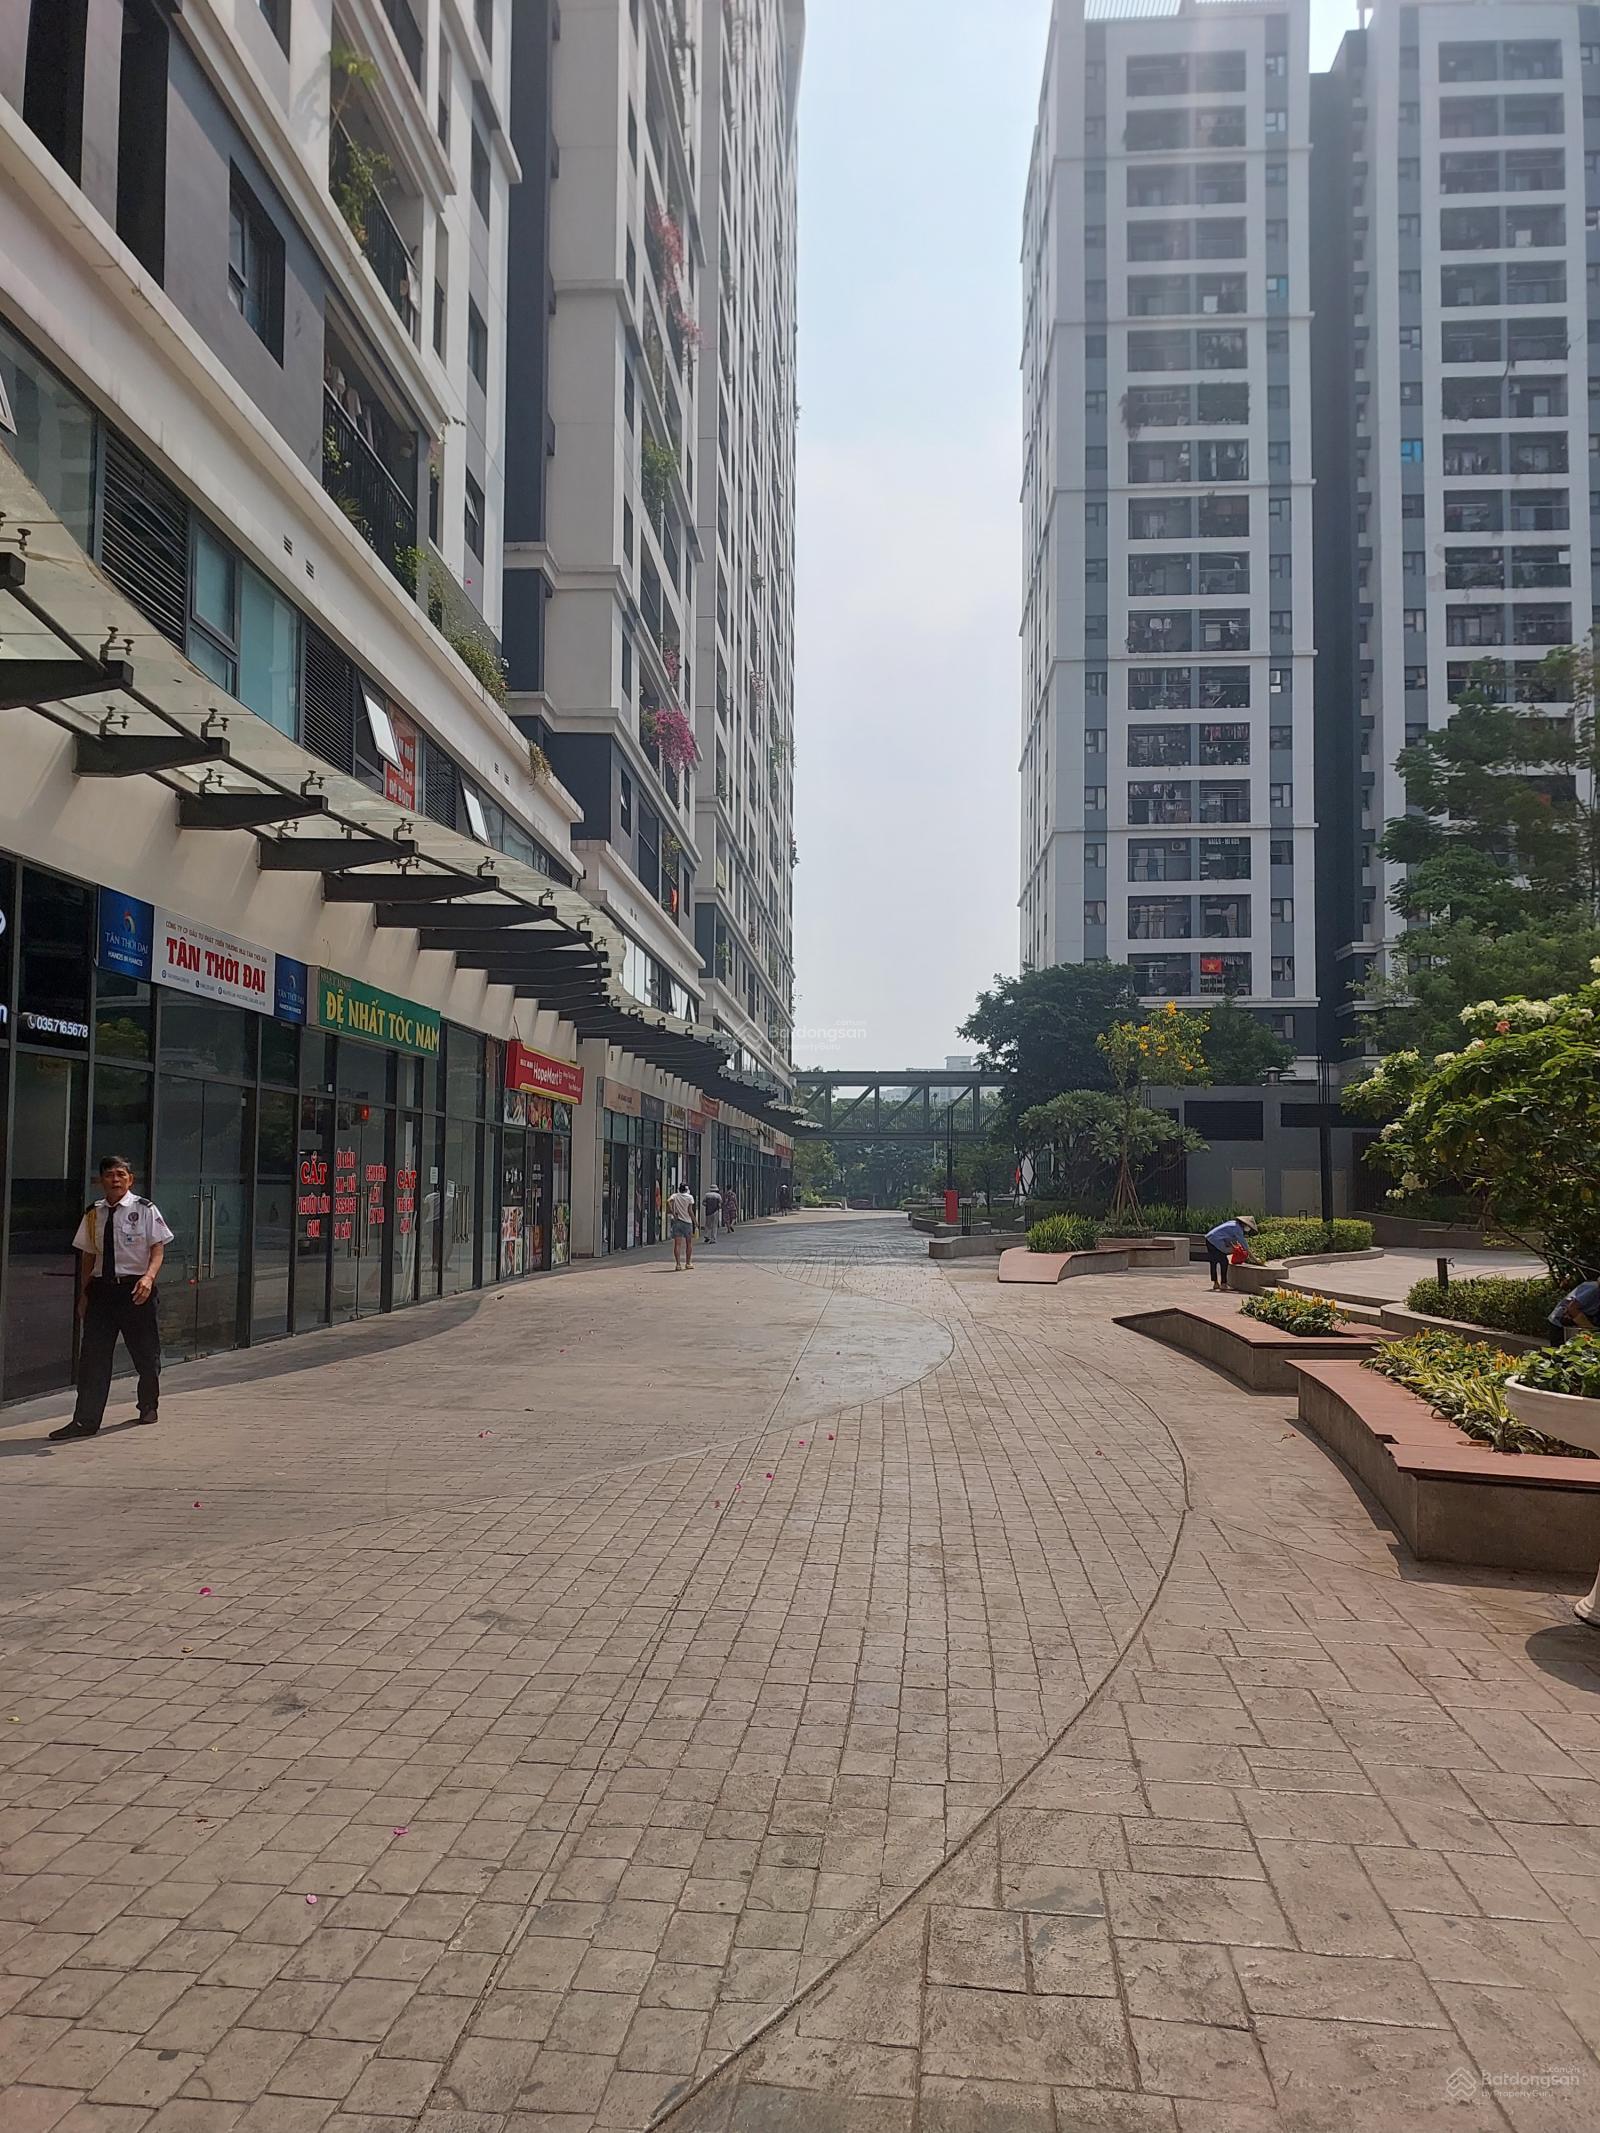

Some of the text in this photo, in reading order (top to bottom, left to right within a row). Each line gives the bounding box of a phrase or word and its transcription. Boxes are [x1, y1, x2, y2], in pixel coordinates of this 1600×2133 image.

[166, 936, 266, 995] TÂN THỜI ĐẠI
[326, 989, 440, 1053] ĐỆ NHẤT TÓC NAM
[300, 1151, 327, 1185] CẮT
[335, 1196, 357, 1215] ASSAGE
